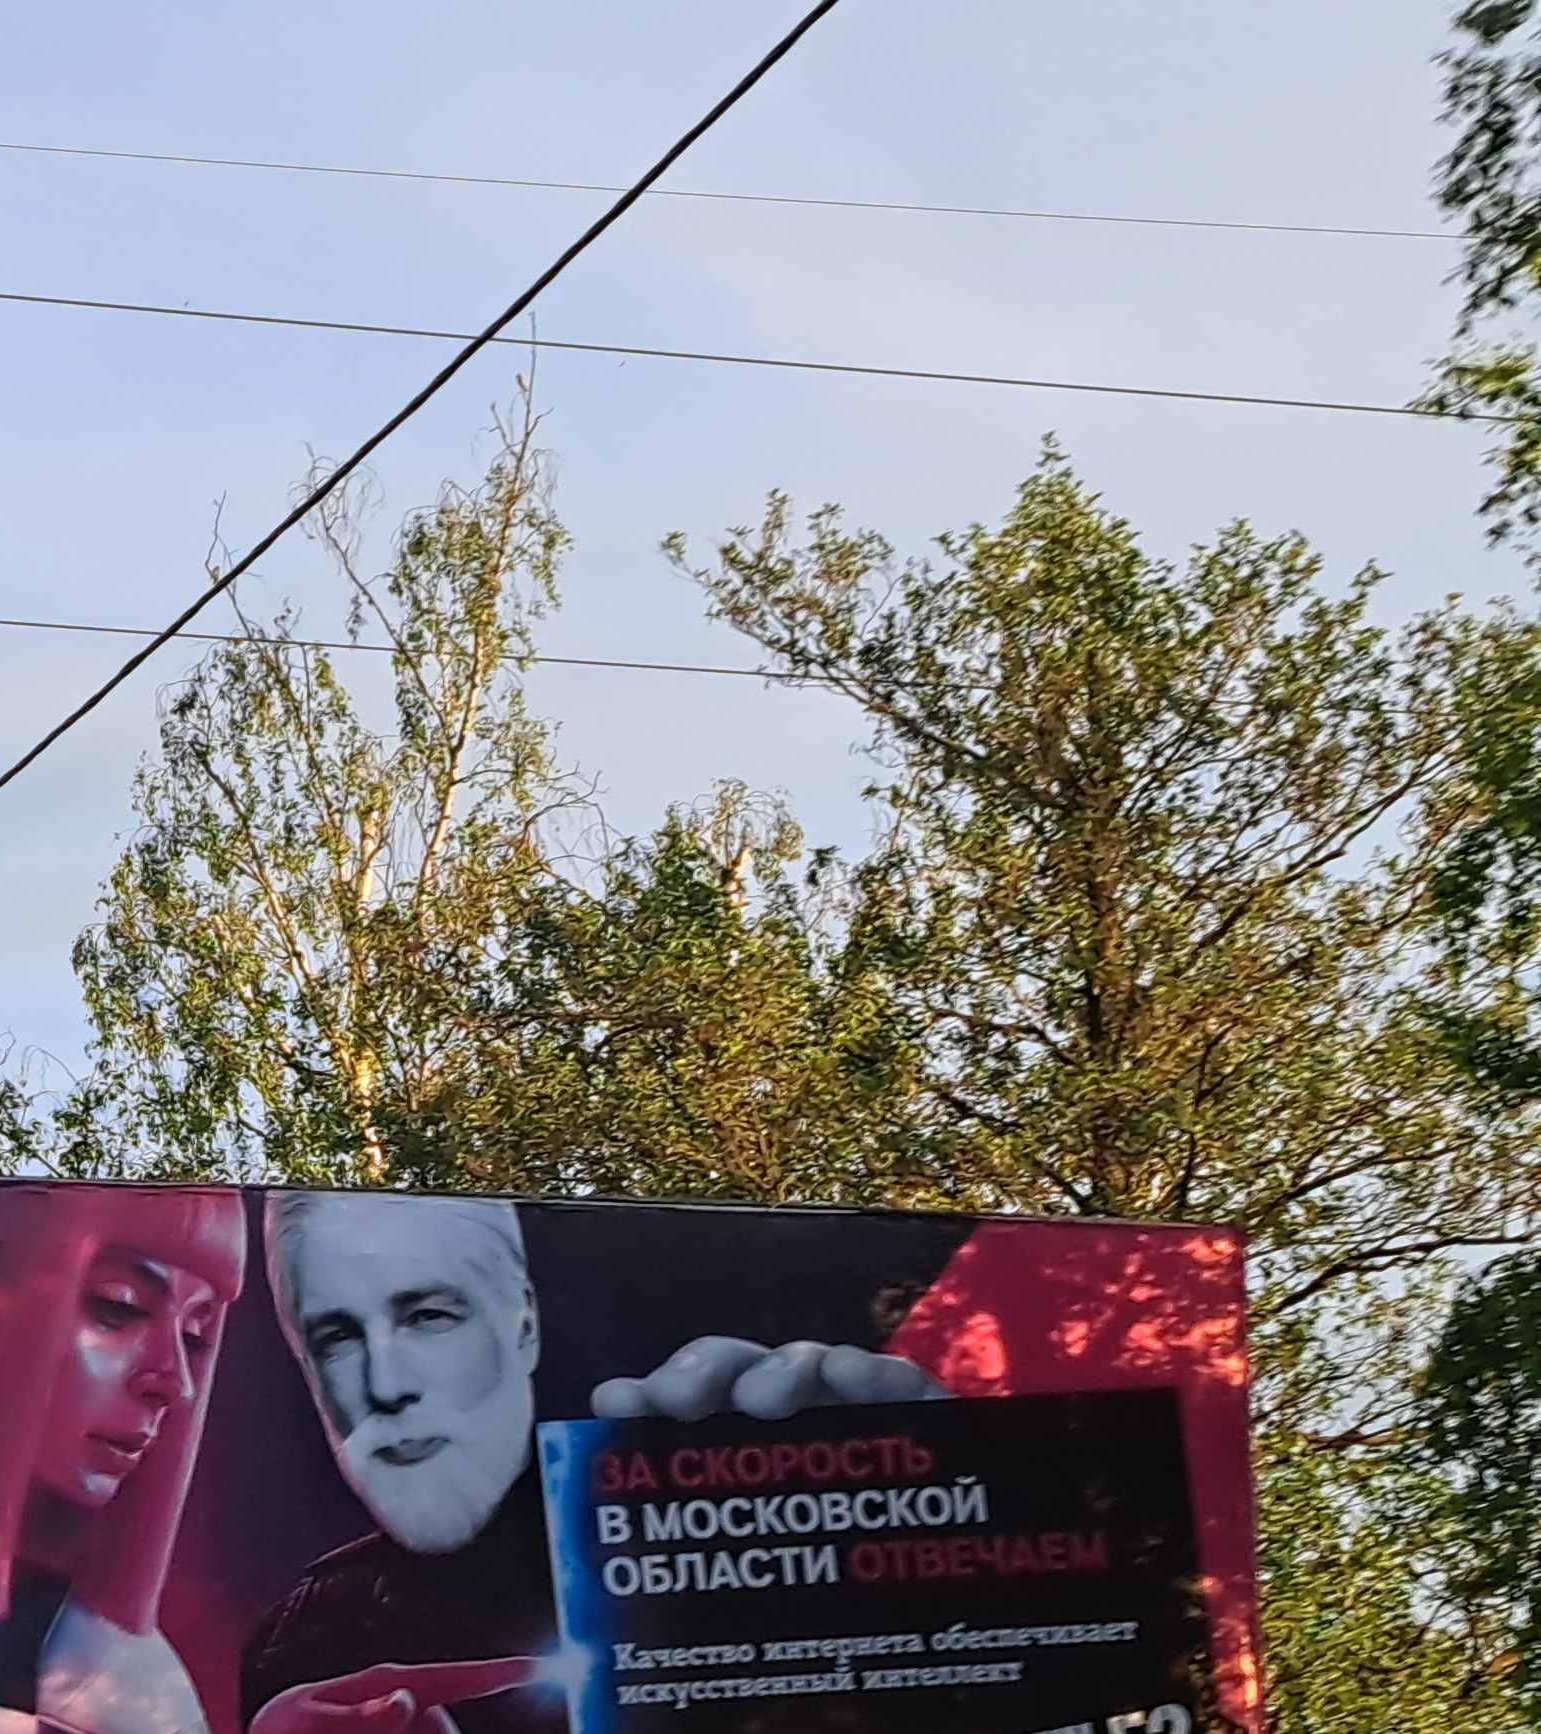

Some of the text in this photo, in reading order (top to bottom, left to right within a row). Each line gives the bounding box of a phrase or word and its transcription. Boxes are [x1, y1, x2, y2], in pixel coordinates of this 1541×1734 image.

[599, 1436, 934, 1491] ЗА СКОРОСТЬ
[596, 1475, 990, 1545] В МОСКОВСКОЙ
[602, 1531, 1110, 1596] ОБЛАСТИ ОТВЕЧАЕМ
[613, 1621, 1140, 1670] Качество интернета обеспечивает
[617, 1665, 857, 1709] искусственный
